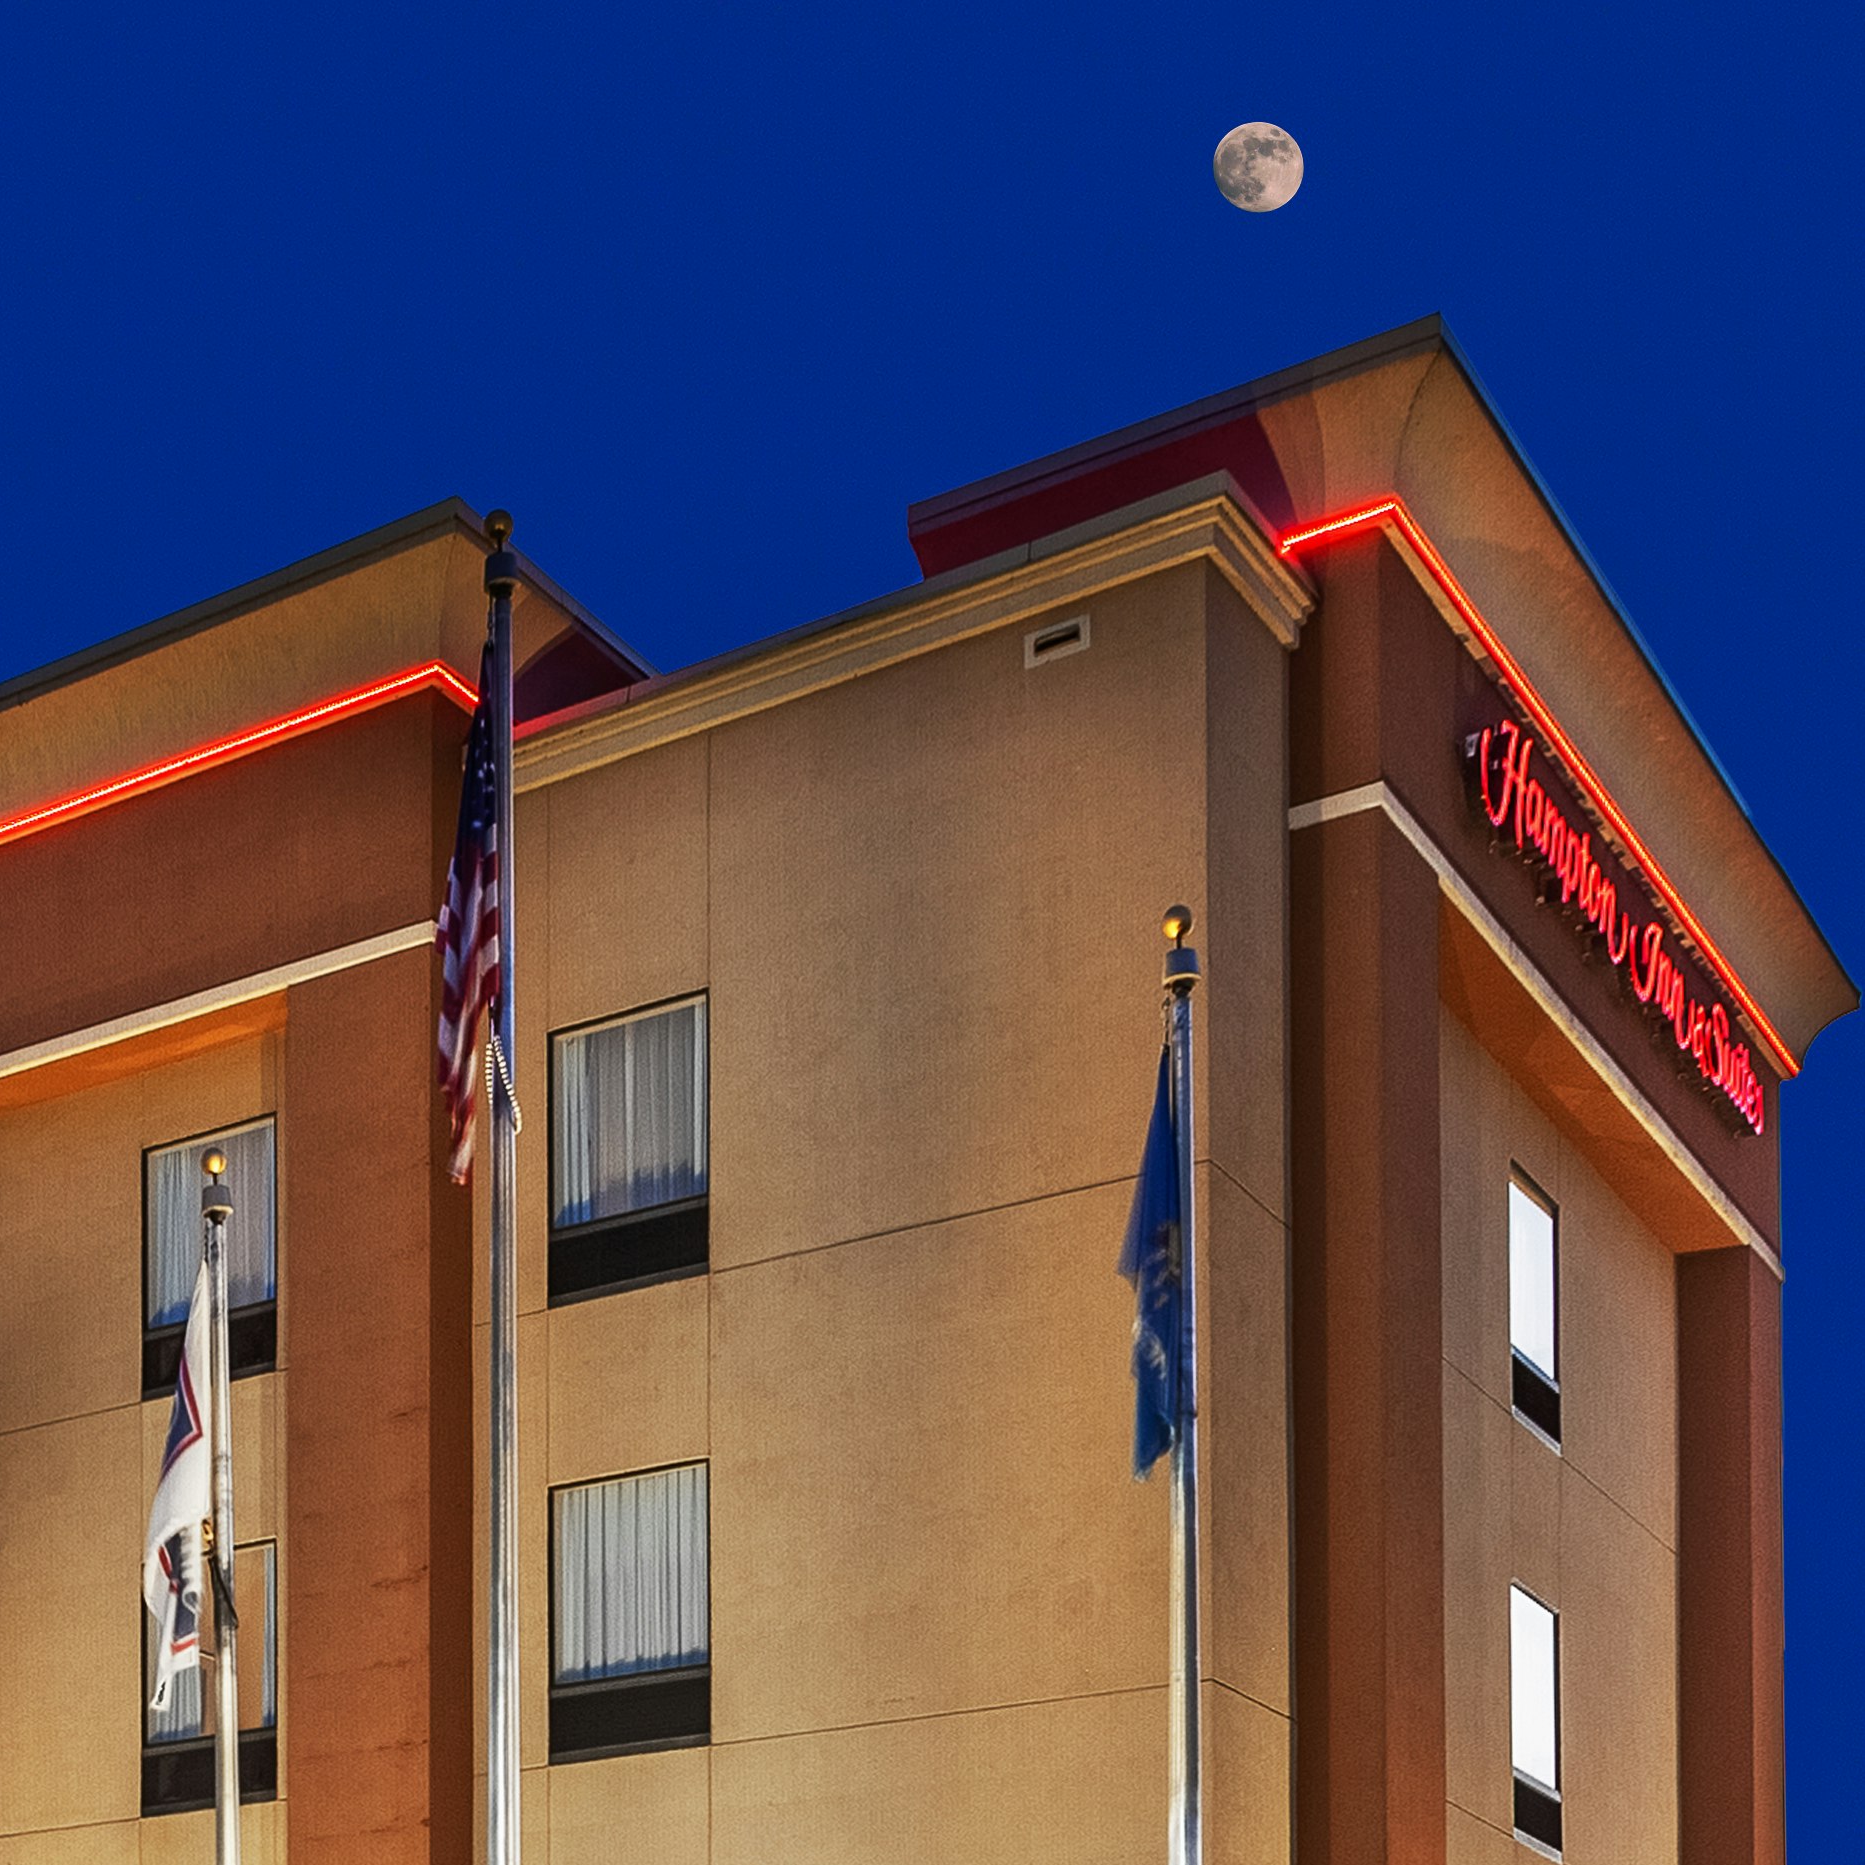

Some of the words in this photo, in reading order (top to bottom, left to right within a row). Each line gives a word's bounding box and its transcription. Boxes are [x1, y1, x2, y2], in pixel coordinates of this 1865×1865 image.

[1481, 719, 1629, 965] Hampton
[1629, 922, 1696, 1049] Inn
[1705, 1002, 1764, 1136] Suites
